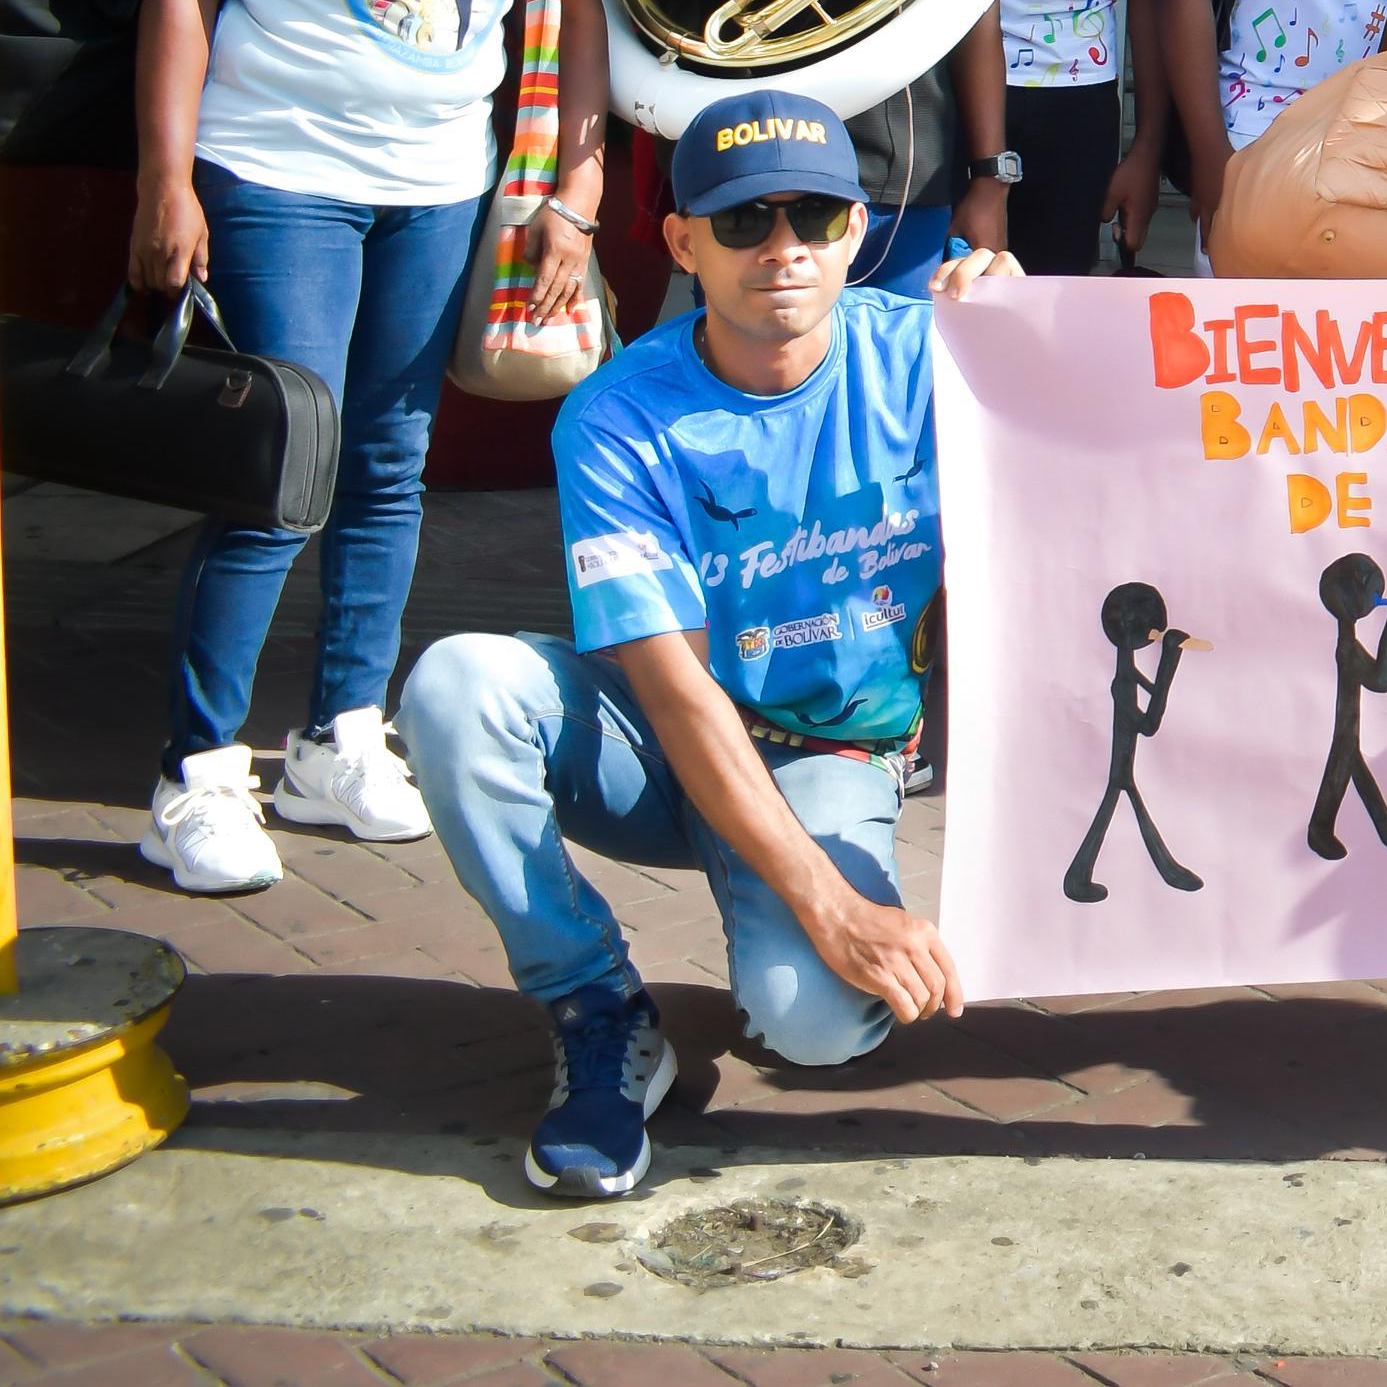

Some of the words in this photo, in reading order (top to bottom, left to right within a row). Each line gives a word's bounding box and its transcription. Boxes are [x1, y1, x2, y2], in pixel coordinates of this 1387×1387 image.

[716, 117, 828, 151] BOLIVAR
[1287, 472, 1373, 534] DE
[700, 551, 728, 587] 13
[740, 509, 919, 589] Festibandas
[822, 557, 849, 585] de
[774, 615, 837, 635] GOBERNACIÓN
